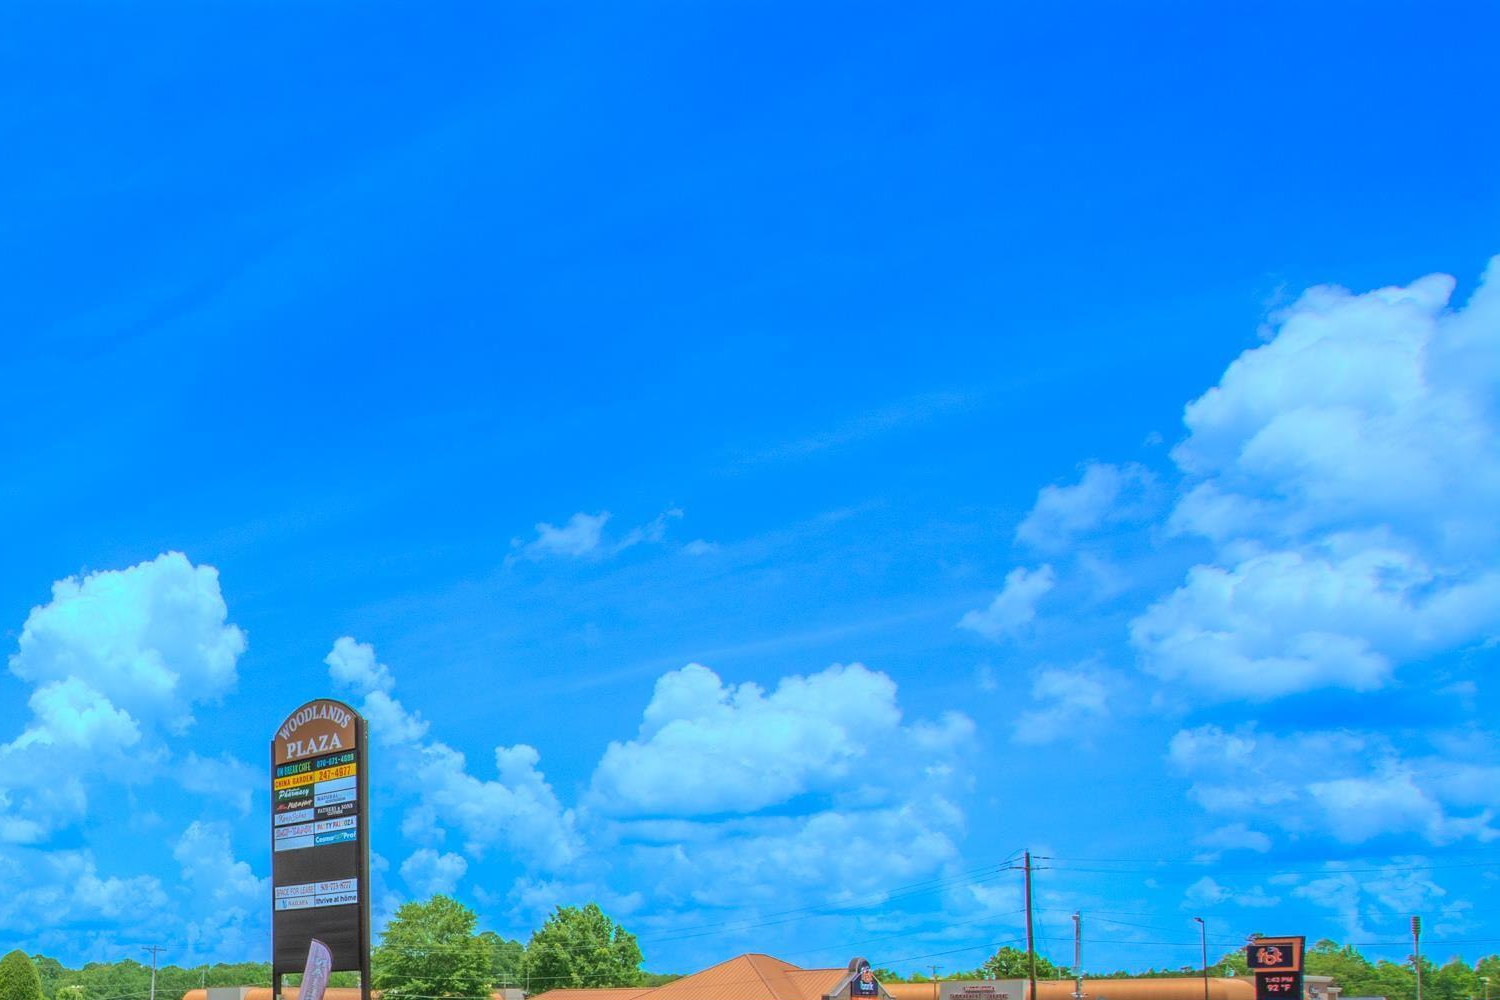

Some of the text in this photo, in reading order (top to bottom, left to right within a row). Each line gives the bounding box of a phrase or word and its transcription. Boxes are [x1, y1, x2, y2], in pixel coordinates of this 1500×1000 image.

[279, 704, 351, 740] WOODLANDS
[287, 732, 342, 760] PLAZA
[299, 761, 312, 772] CAFE
[1267, 984, 1279, 992] 92
